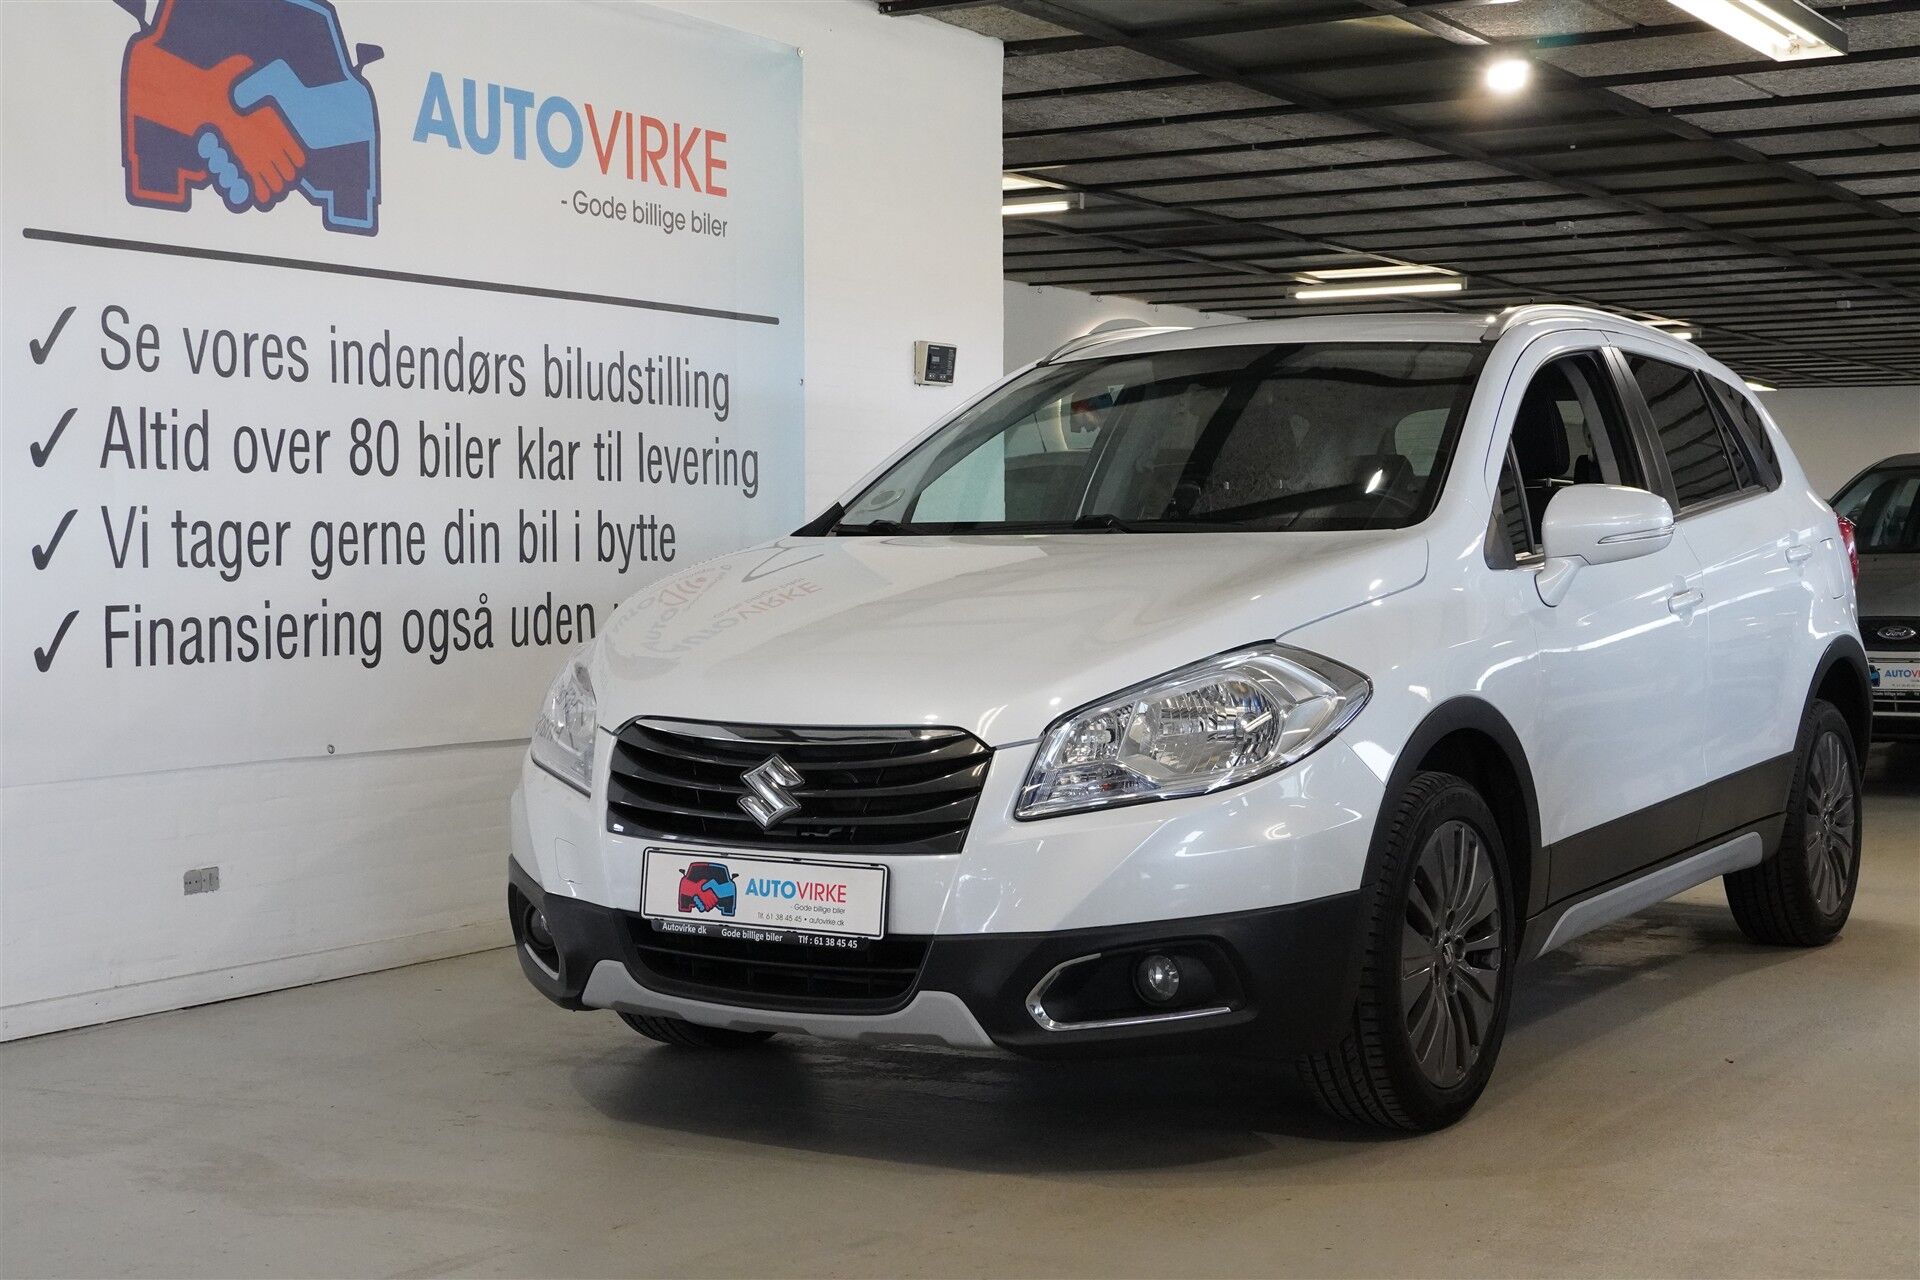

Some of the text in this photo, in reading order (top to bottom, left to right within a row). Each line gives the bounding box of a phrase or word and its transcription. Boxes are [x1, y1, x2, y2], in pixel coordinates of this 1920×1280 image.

[413, 71, 727, 198] AUTOVIRKE
[572, 189, 627, 221] Gode
[633, 200, 686, 235] billige
[691, 210, 728, 238] biler
[100, 304, 731, 422] Se vores indendørs biludstilling
[100, 405, 760, 499] Altid over 80 biler klar til levering
[101, 505, 677, 583] Vi tager gerne din bil i bytte
[104, 598, 382, 669] Finansiering
[402, 592, 494, 666] også
[511, 591, 596, 650] uden
[745, 878, 847, 903] AUTOVIRKE
[793, 903, 846, 915] Gode billige biler
[662, 922, 696, 934] Autovirke
[721, 928, 783, 942] Gode billige biler
[765, 912, 773, 920] 61
[775, 913, 784, 921] 38
[784, 914, 793, 922] 45
[794, 915, 803, 923] 45
[814, 936, 823, 946] 61
[825, 937, 835, 947] 38
[836, 938, 846, 948] 45
[847, 939, 858, 949] 45
